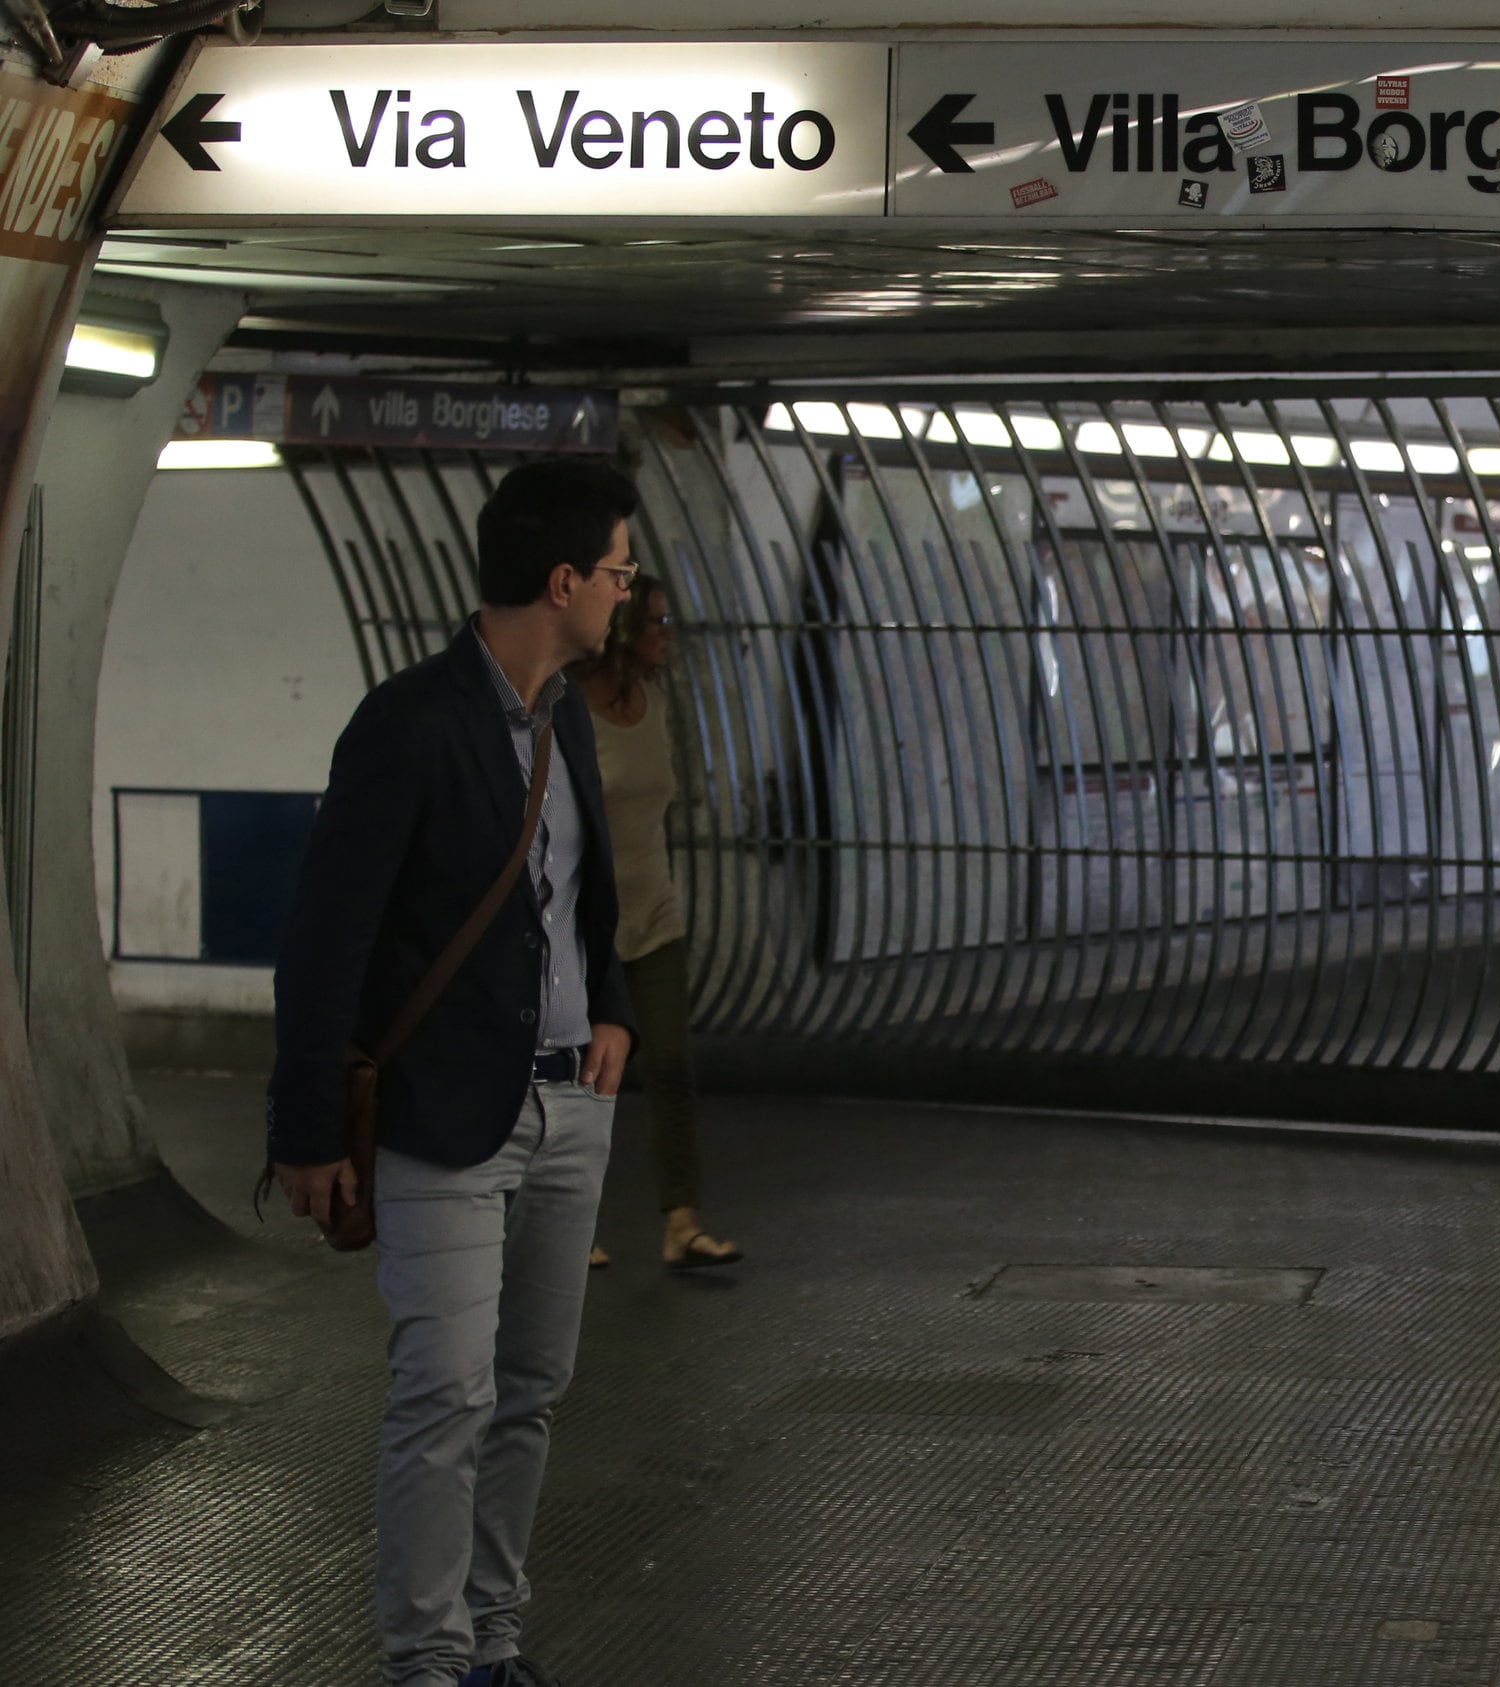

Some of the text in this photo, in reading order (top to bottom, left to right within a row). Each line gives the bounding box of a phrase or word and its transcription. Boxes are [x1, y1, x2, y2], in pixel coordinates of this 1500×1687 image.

[1377, 80, 1407, 88] ULTRAS
[1377, 97, 1407, 105] VIVENDI
[1379, 88, 1405, 96] MODUS
[328, 89, 836, 171] Via Veneto
[1043, 92, 1237, 174] Villa
[221, 384, 243, 429] P
[432, 392, 550, 440] Borghese
